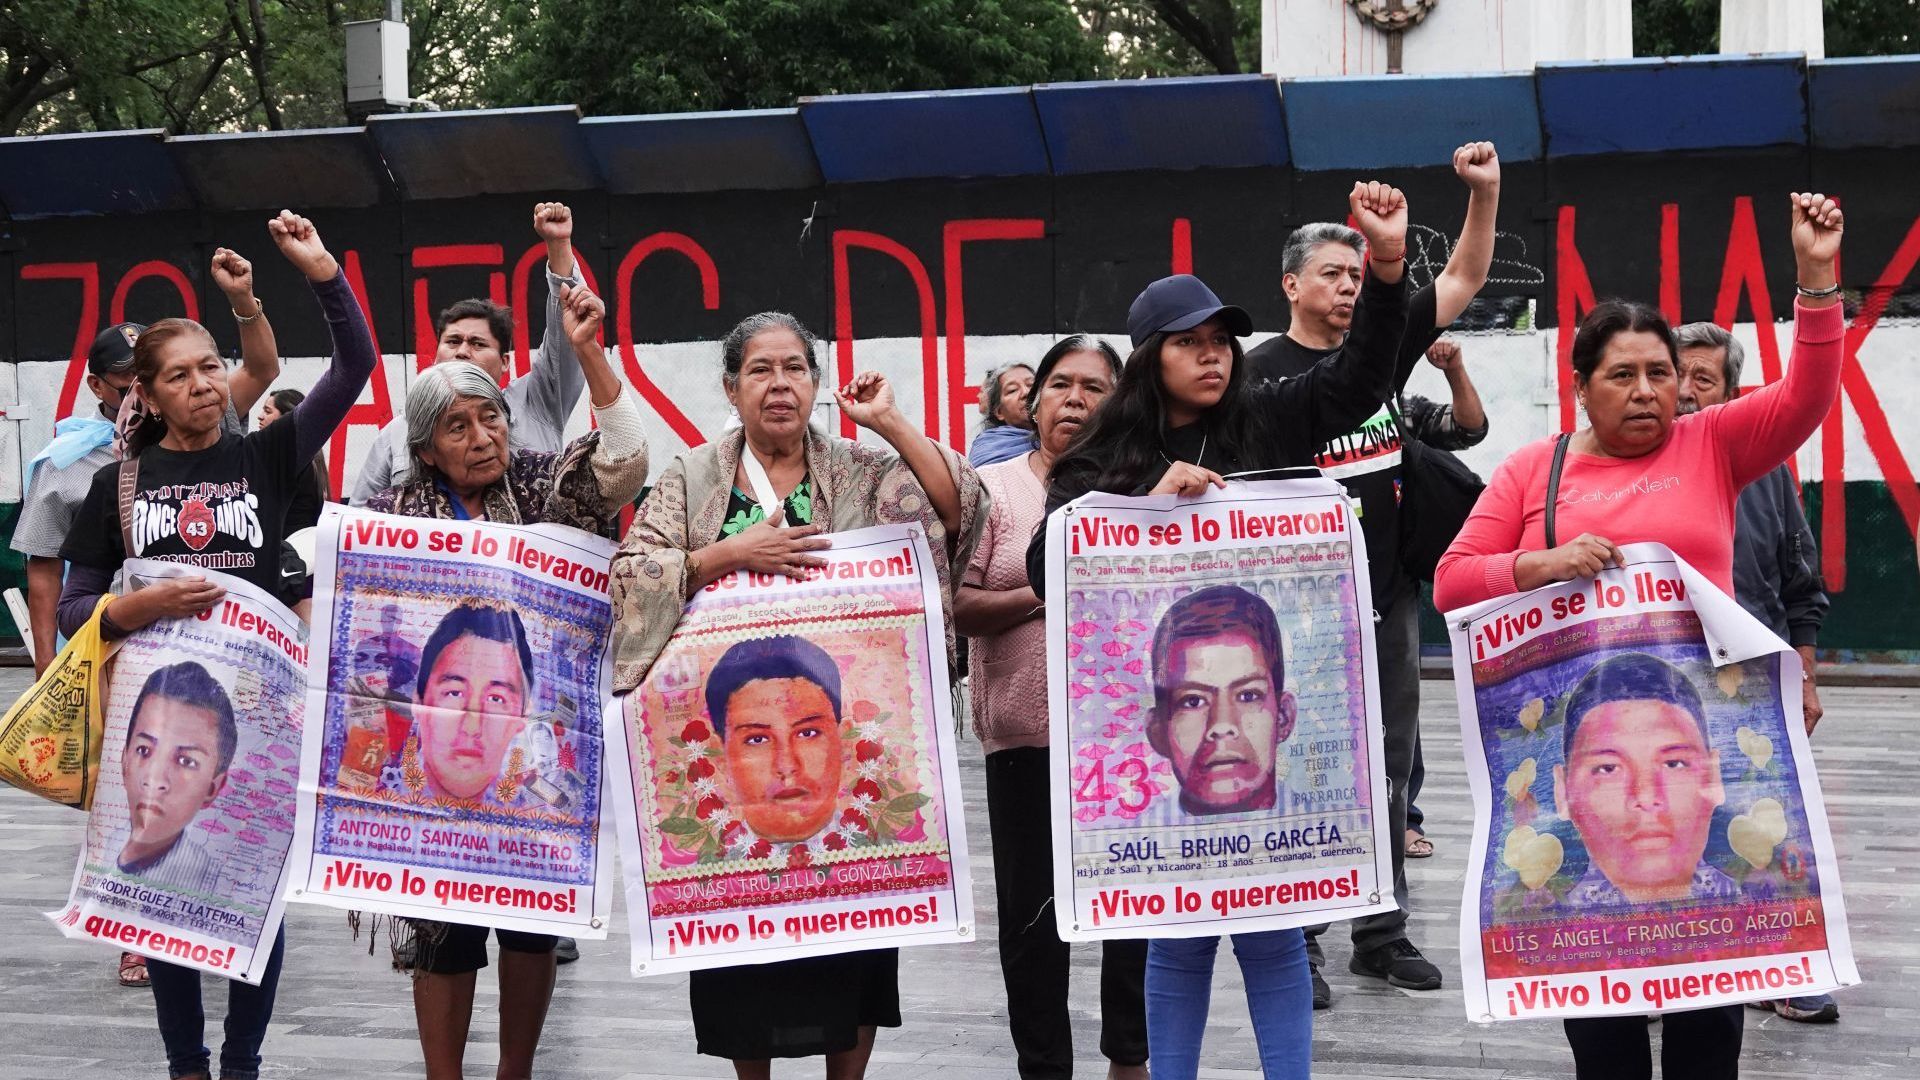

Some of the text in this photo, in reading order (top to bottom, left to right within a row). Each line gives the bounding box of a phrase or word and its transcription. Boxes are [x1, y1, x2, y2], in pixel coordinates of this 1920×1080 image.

[1632, 475, 1680, 494] Klein
[132, 493, 264, 557] ONCE 43 AÑOS
[344, 519, 419, 551] ¡Vivo
[428, 530, 463, 553] se
[471, 529, 498, 557] lo
[1072, 503, 1345, 555] ¡Vivo se lo llevaron!
[190, 551, 256, 570] sombras
[420, 565, 461, 577] Glasgow,
[1238, 558, 1266, 569] quiero
[1271, 556, 1294, 565] saber
[221, 600, 309, 668] llevaron!
[1474, 607, 1543, 660] ¡Vivo
[1550, 591, 1586, 620] se
[1594, 579, 1625, 609] lo
[1553, 631, 1592, 647] Glasgow,
[1075, 758, 1153, 814] 43
[328, 836, 350, 847] Hijo
[353, 839, 364, 847] de
[367, 840, 416, 855] Magdalena,
[420, 847, 447, 858] Nieto
[450, 851, 460, 860] de
[338, 819, 572, 861] ANTONIO SANTANA MAESTRO
[1108, 821, 1342, 863] SAÚL BRUNO GARCÍA
[673, 860, 926, 900] JONÁS TRUJILLO GONZÁLEZ
[1077, 868, 1099, 878] Hijo
[1104, 867, 1115, 875] de
[1147, 866, 1153, 874] y
[1157, 862, 1201, 872] Nicanora
[1217, 860, 1228, 868] 18
[1233, 857, 1254, 867] años
[1269, 851, 1316, 863] Tecoanapa,
[99, 878, 173, 908] RODRÍGUEZ
[180, 900, 245, 928] TLATEMPA
[322, 860, 577, 913] ¡Vivo lo queremos!
[654, 905, 674, 914] Hijo
[678, 902, 687, 910] de
[770, 893, 779, 901] de
[840, 885, 859, 894] años
[872, 883, 882, 891] El
[1091, 869, 1360, 926] ¡Vivo lo queremos!
[85, 914, 236, 969] queremos!
[667, 896, 939, 955] ¡Vivo lo queremos!
[1491, 909, 1817, 954] LUÍS ÁNGEL FRANCISCO ARZOLA
[1518, 955, 1541, 965] Hijo
[1546, 953, 1557, 962] de
[1563, 950, 1602, 961] Lorenzo
[1606, 950, 1613, 959] y
[1617, 946, 1657, 957] Benigna
[1688, 940, 1709, 949] años
[1723, 937, 1740, 947] San
[1506, 957, 1815, 1016] ¡Vivo lo queremos!
